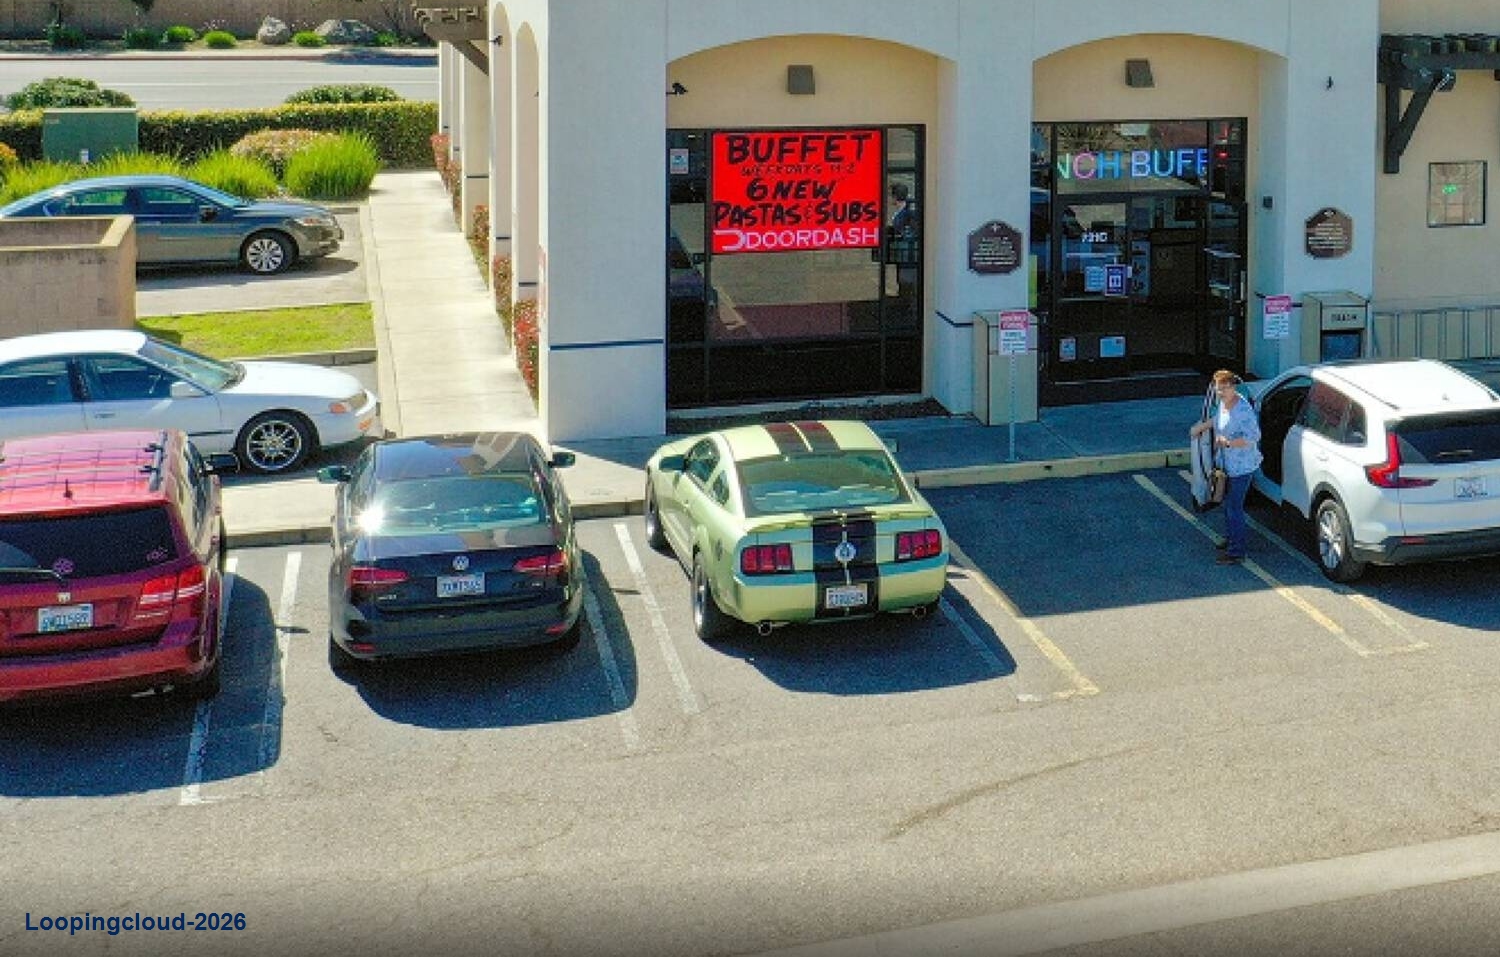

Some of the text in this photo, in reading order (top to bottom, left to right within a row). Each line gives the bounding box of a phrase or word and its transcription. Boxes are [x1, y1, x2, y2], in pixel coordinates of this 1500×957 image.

[726, 133, 873, 165] BUFFET
[747, 178, 837, 201] 6 NEW
[713, 201, 802, 228] PASTAS
[815, 198, 878, 224] SUBS
